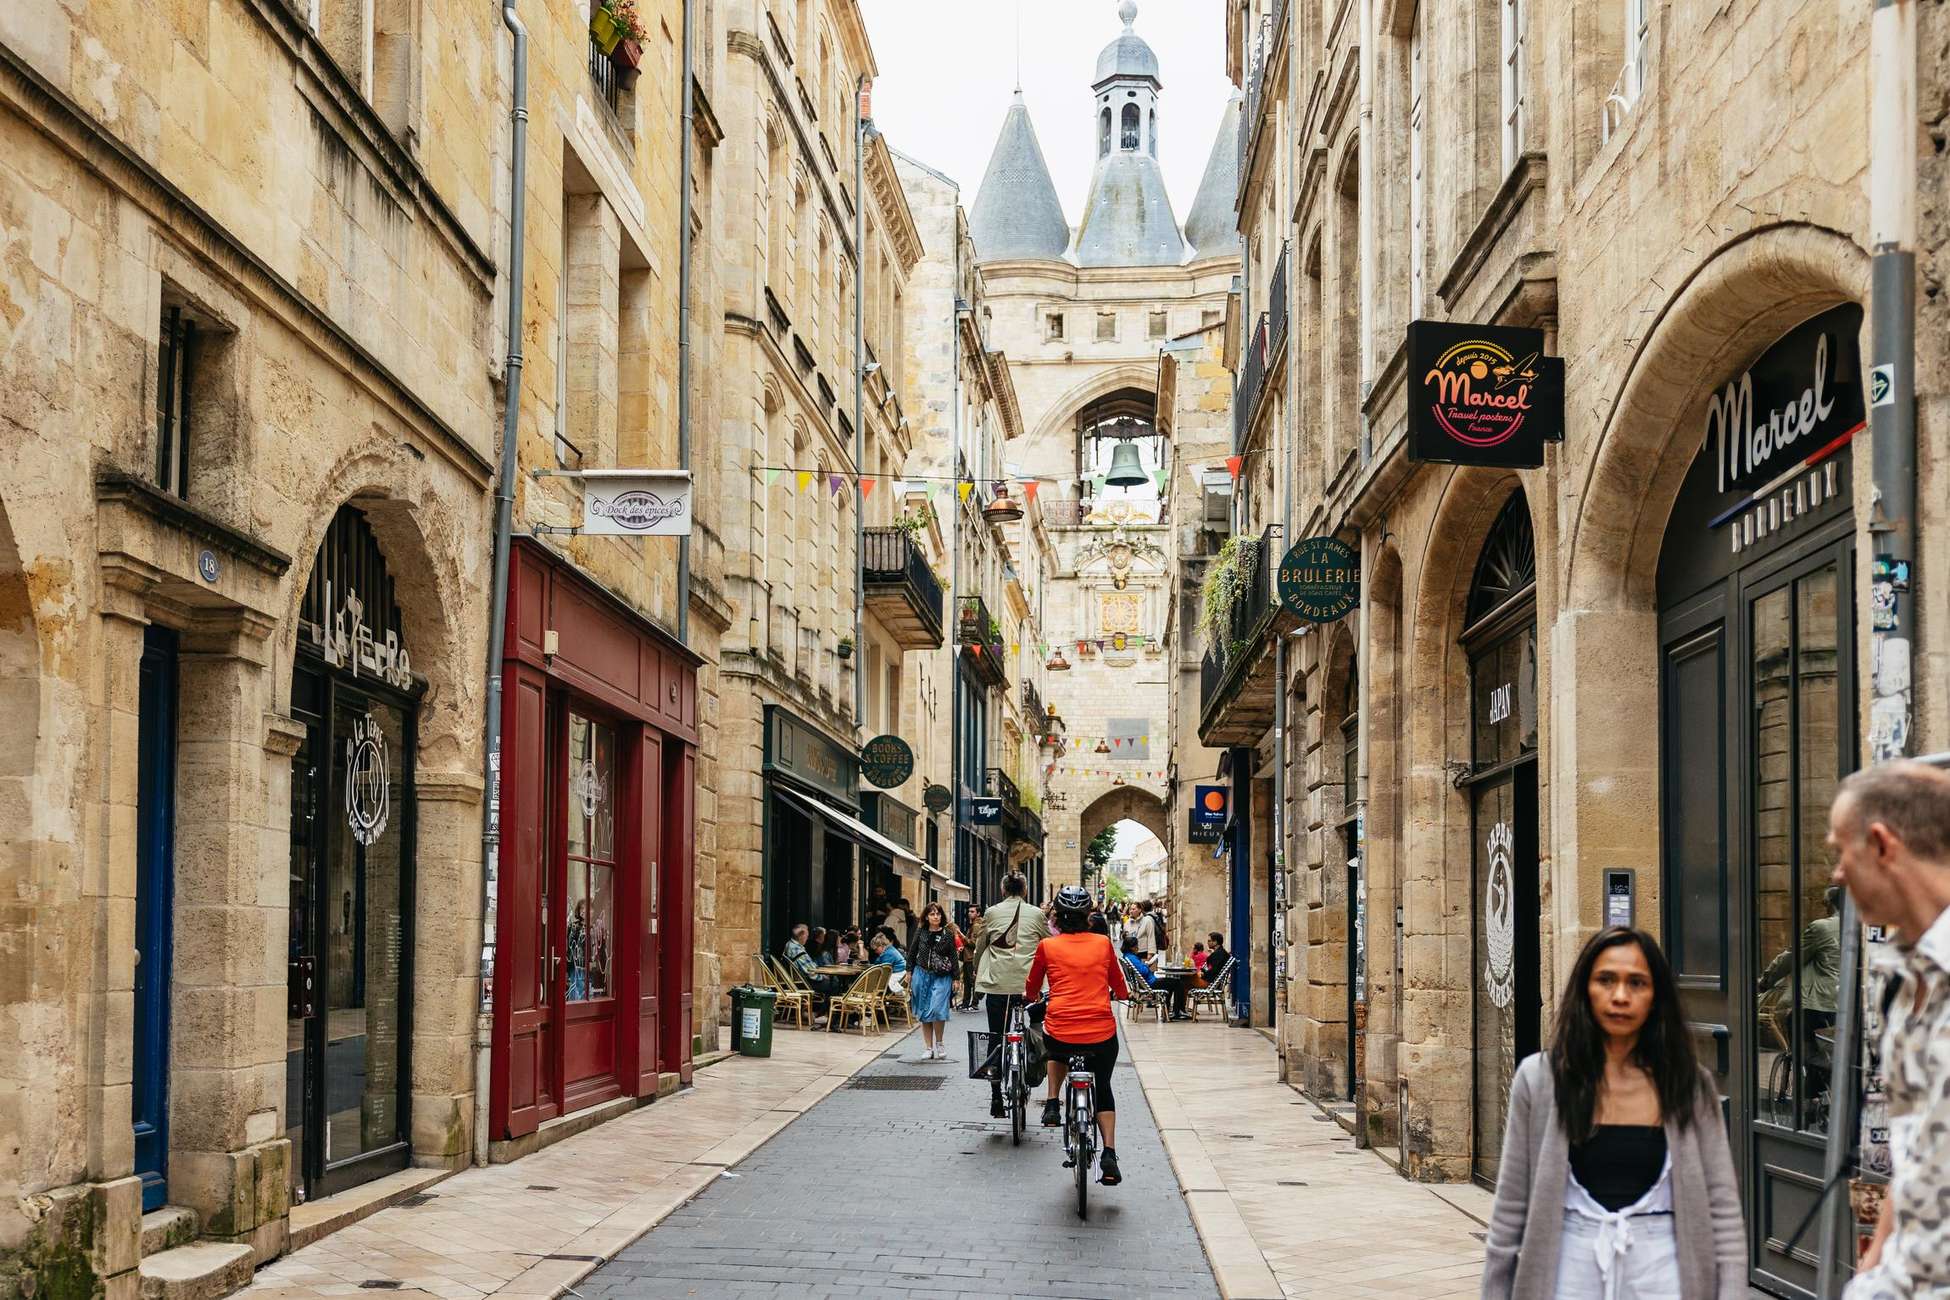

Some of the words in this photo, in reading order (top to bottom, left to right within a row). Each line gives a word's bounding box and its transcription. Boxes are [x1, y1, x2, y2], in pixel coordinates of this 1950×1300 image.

[1456, 352, 1479, 366] depuis
[1479, 352, 1497, 365] 2015
[1424, 368, 1532, 410] Marcel
[1447, 407, 1479, 420] Travel
[1479, 412, 1513, 423] posters
[1703, 332, 1835, 493] Marcel
[1467, 422, 1493, 432] France
[629, 503, 643, 514] des
[1732, 461, 1838, 553] BORDEAUX
[1293, 544, 1309, 559] RUE
[1311, 541, 1321, 549] ST
[1324, 541, 1350, 559] JAMES
[1312, 552, 1329, 564] LA
[204, 557, 215, 574] 18
[1281, 568, 1361, 583] BRULERIE
[1289, 593, 1355, 617] BORDEAUX
[1490, 682, 1511, 725] JAPAN
[873, 753, 910, 764] COFFEE
[1486, 822, 1513, 866] JAPAN
